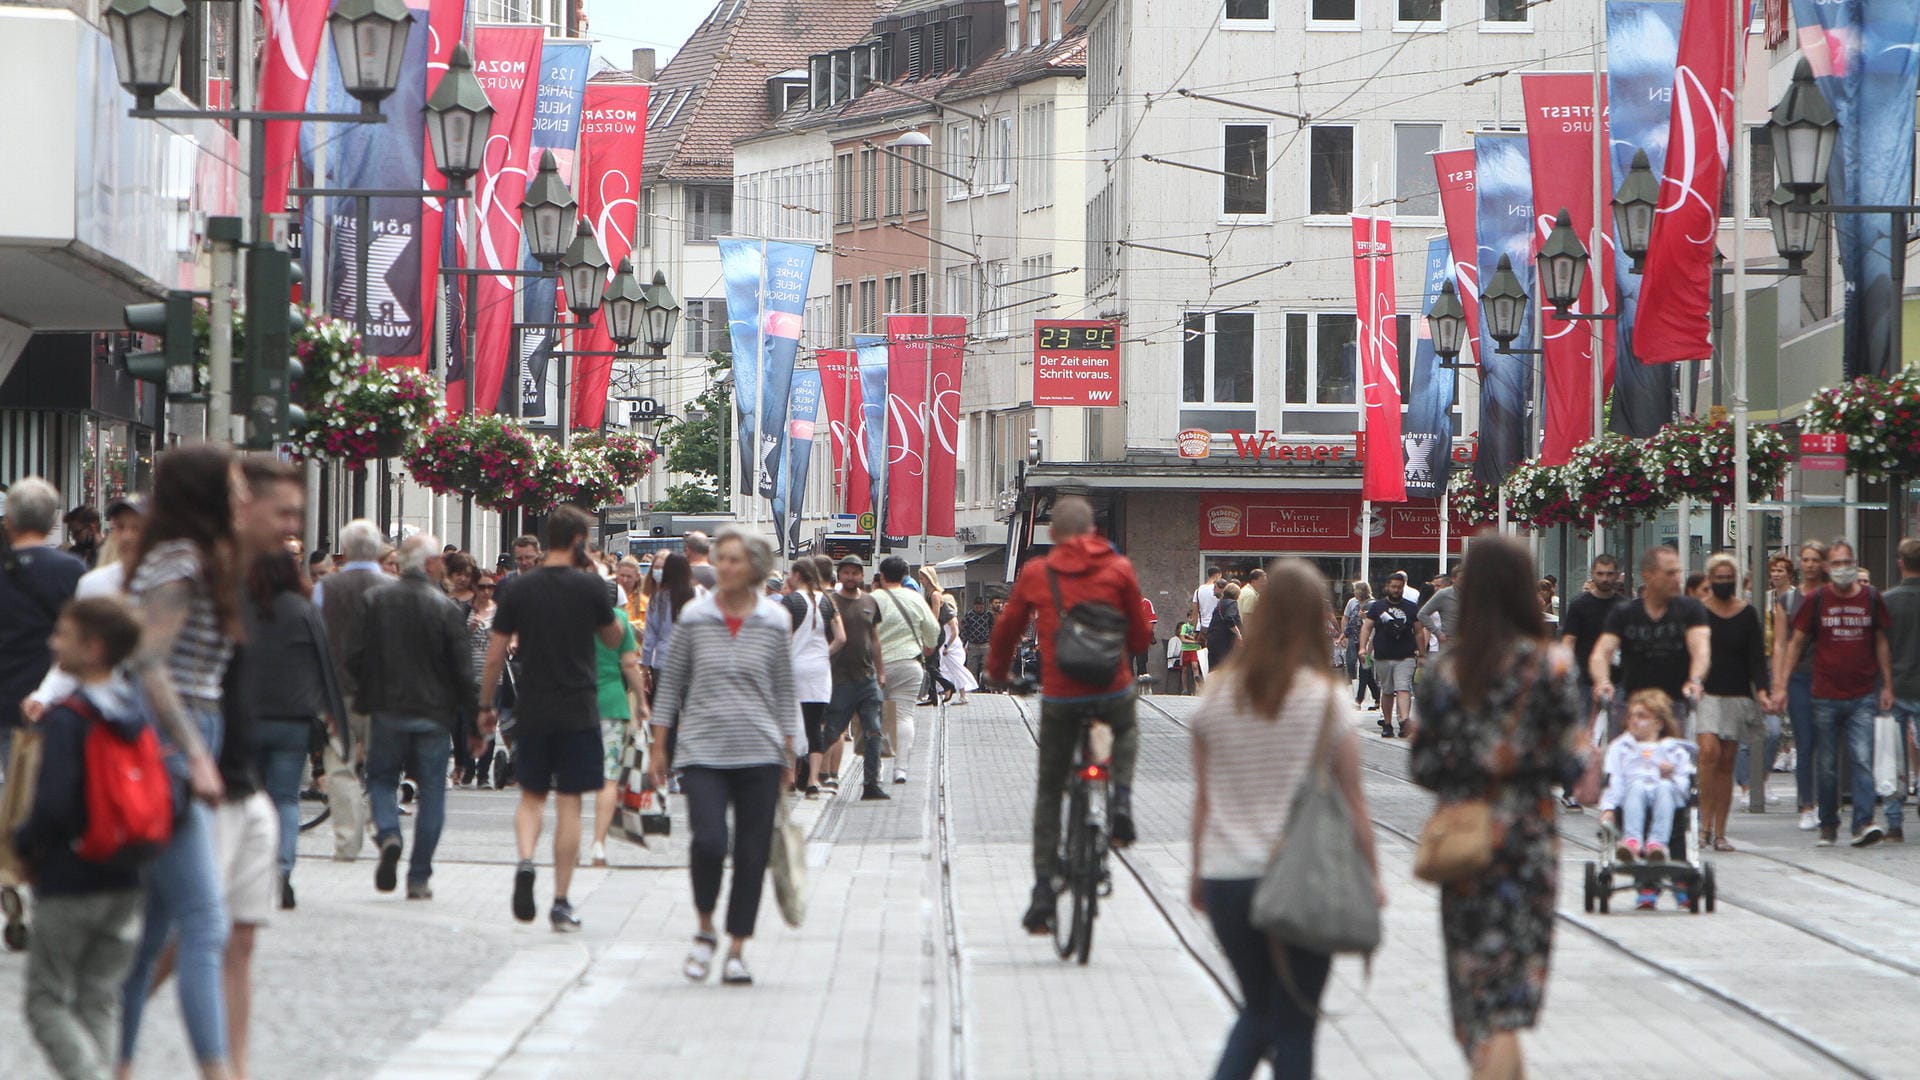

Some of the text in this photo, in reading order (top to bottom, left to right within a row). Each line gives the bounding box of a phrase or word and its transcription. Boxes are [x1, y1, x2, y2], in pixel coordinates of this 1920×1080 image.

[1040, 328, 1070, 348] 23
[1040, 355, 1109, 366] Der Zeit einen
[1040, 368, 1112, 379] Schritt voraus.
[1088, 391, 1112, 400] WVV
[1225, 429, 1345, 461] Wiener
[1280, 509, 1320, 521] Wiener
[1270, 521, 1329, 534] Feinbäcker
